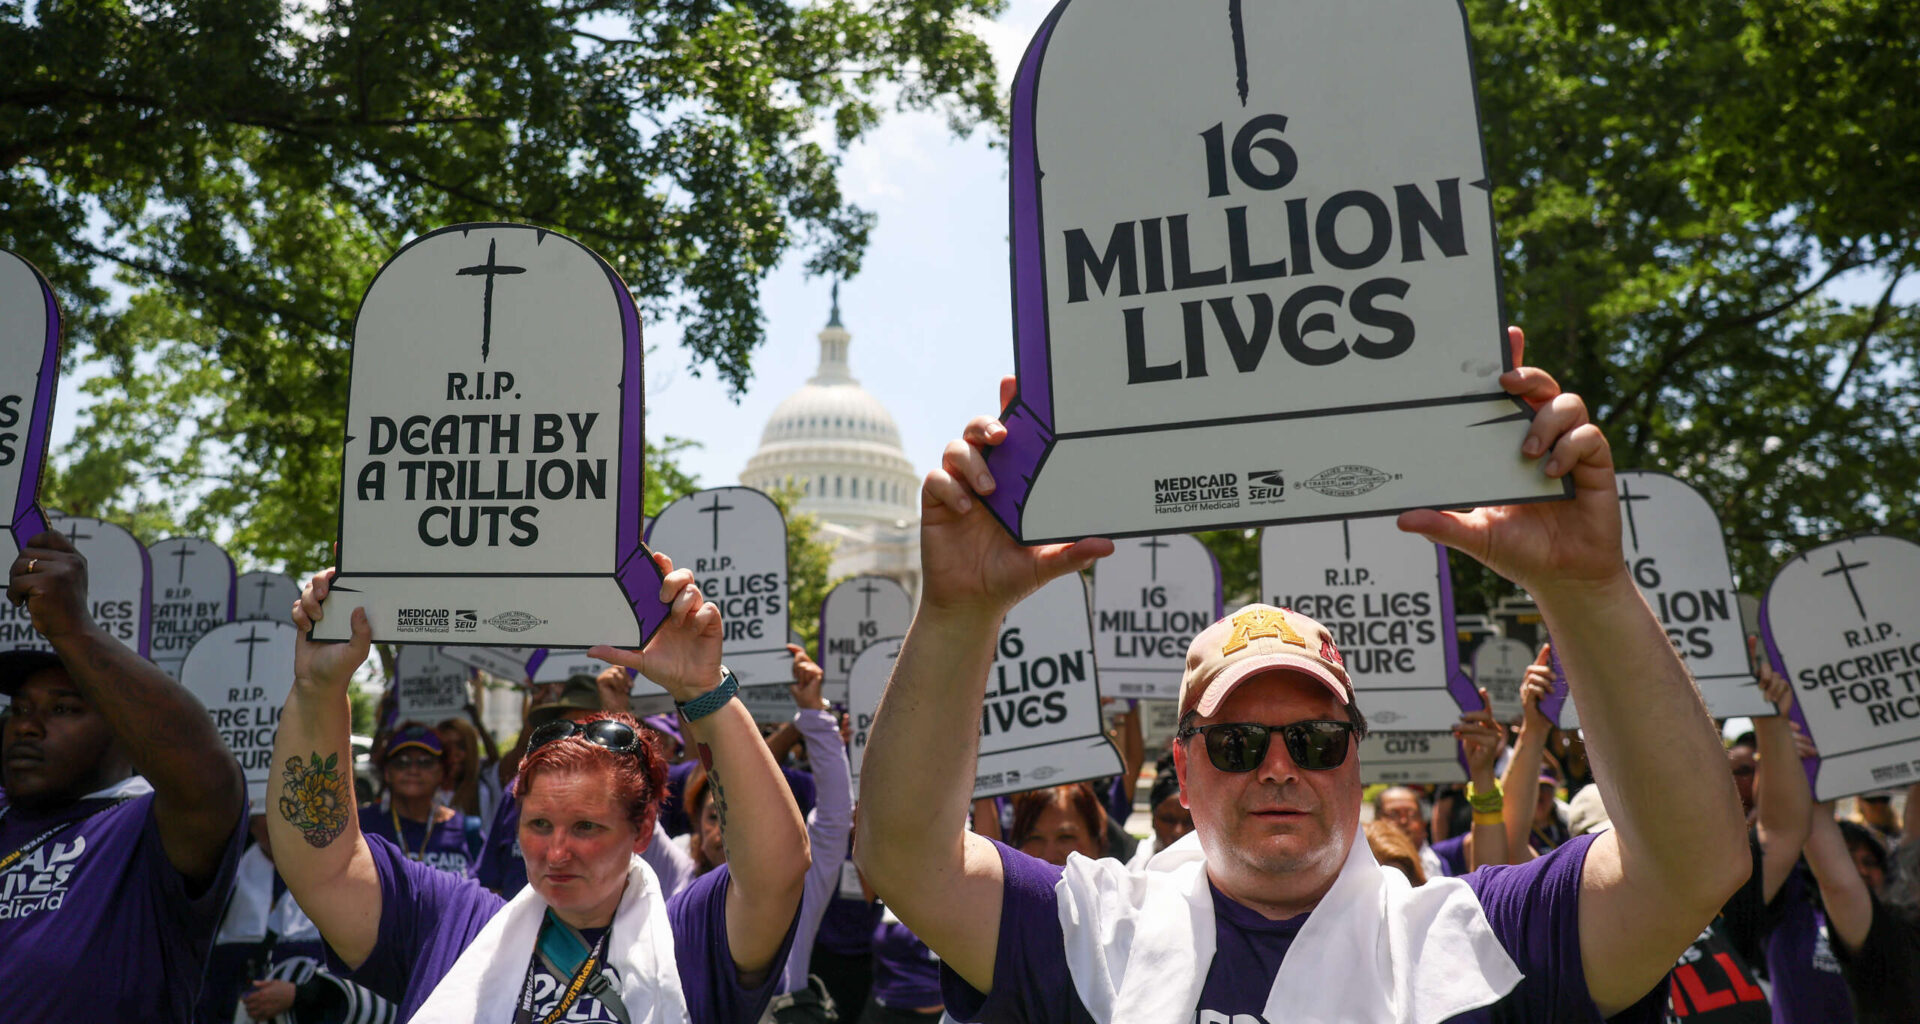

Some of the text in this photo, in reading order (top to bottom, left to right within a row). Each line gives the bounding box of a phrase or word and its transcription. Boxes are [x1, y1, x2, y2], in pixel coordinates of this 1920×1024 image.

[1198, 113, 1299, 199] 16
[1063, 177, 1469, 304] MILLION
[1122, 277, 1416, 385] LIVES
[446, 371, 521, 401] R.I.P.
[368, 412, 600, 455] DEATH BY
[357, 458, 608, 501] A TRILLION
[1154, 473, 1238, 492] MEDICAID
[1155, 486, 1239, 504] SAVES LIVES
[1248, 487, 1284, 499] SEIU
[1155, 501, 1240, 514] Hands Off Medicaid
[418, 505, 540, 547] CUTS
[696, 556, 736, 572] R.I.P.
[725, 572, 779, 596] LIES
[1326, 568, 1375, 586] R.I.P.
[1141, 586, 1167, 608] 16
[1364, 592, 1432, 618] LIES
[92, 601, 133, 619] IES
[197, 602, 221, 617] BY
[398, 609, 449, 617] MEDICAID
[397, 618, 449, 626] SAVES LIVES
[454, 621, 477, 629] SEIU
[1100, 610, 1209, 634] MILLION
[1327, 619, 1437, 647] ERICA'S
[1114, 635, 1193, 659] LIVES
[1844, 622, 1901, 648] R.I.P.
[984, 649, 1087, 700] LION
[228, 686, 268, 702] R.I.P.
[1828, 677, 1893, 710] FOR
[979, 691, 1068, 737] IVES
[1867, 694, 1920, 727] RIC
[1384, 738, 1430, 754] CUTS
[560, 958, 596, 1012] REPUBLICAN
